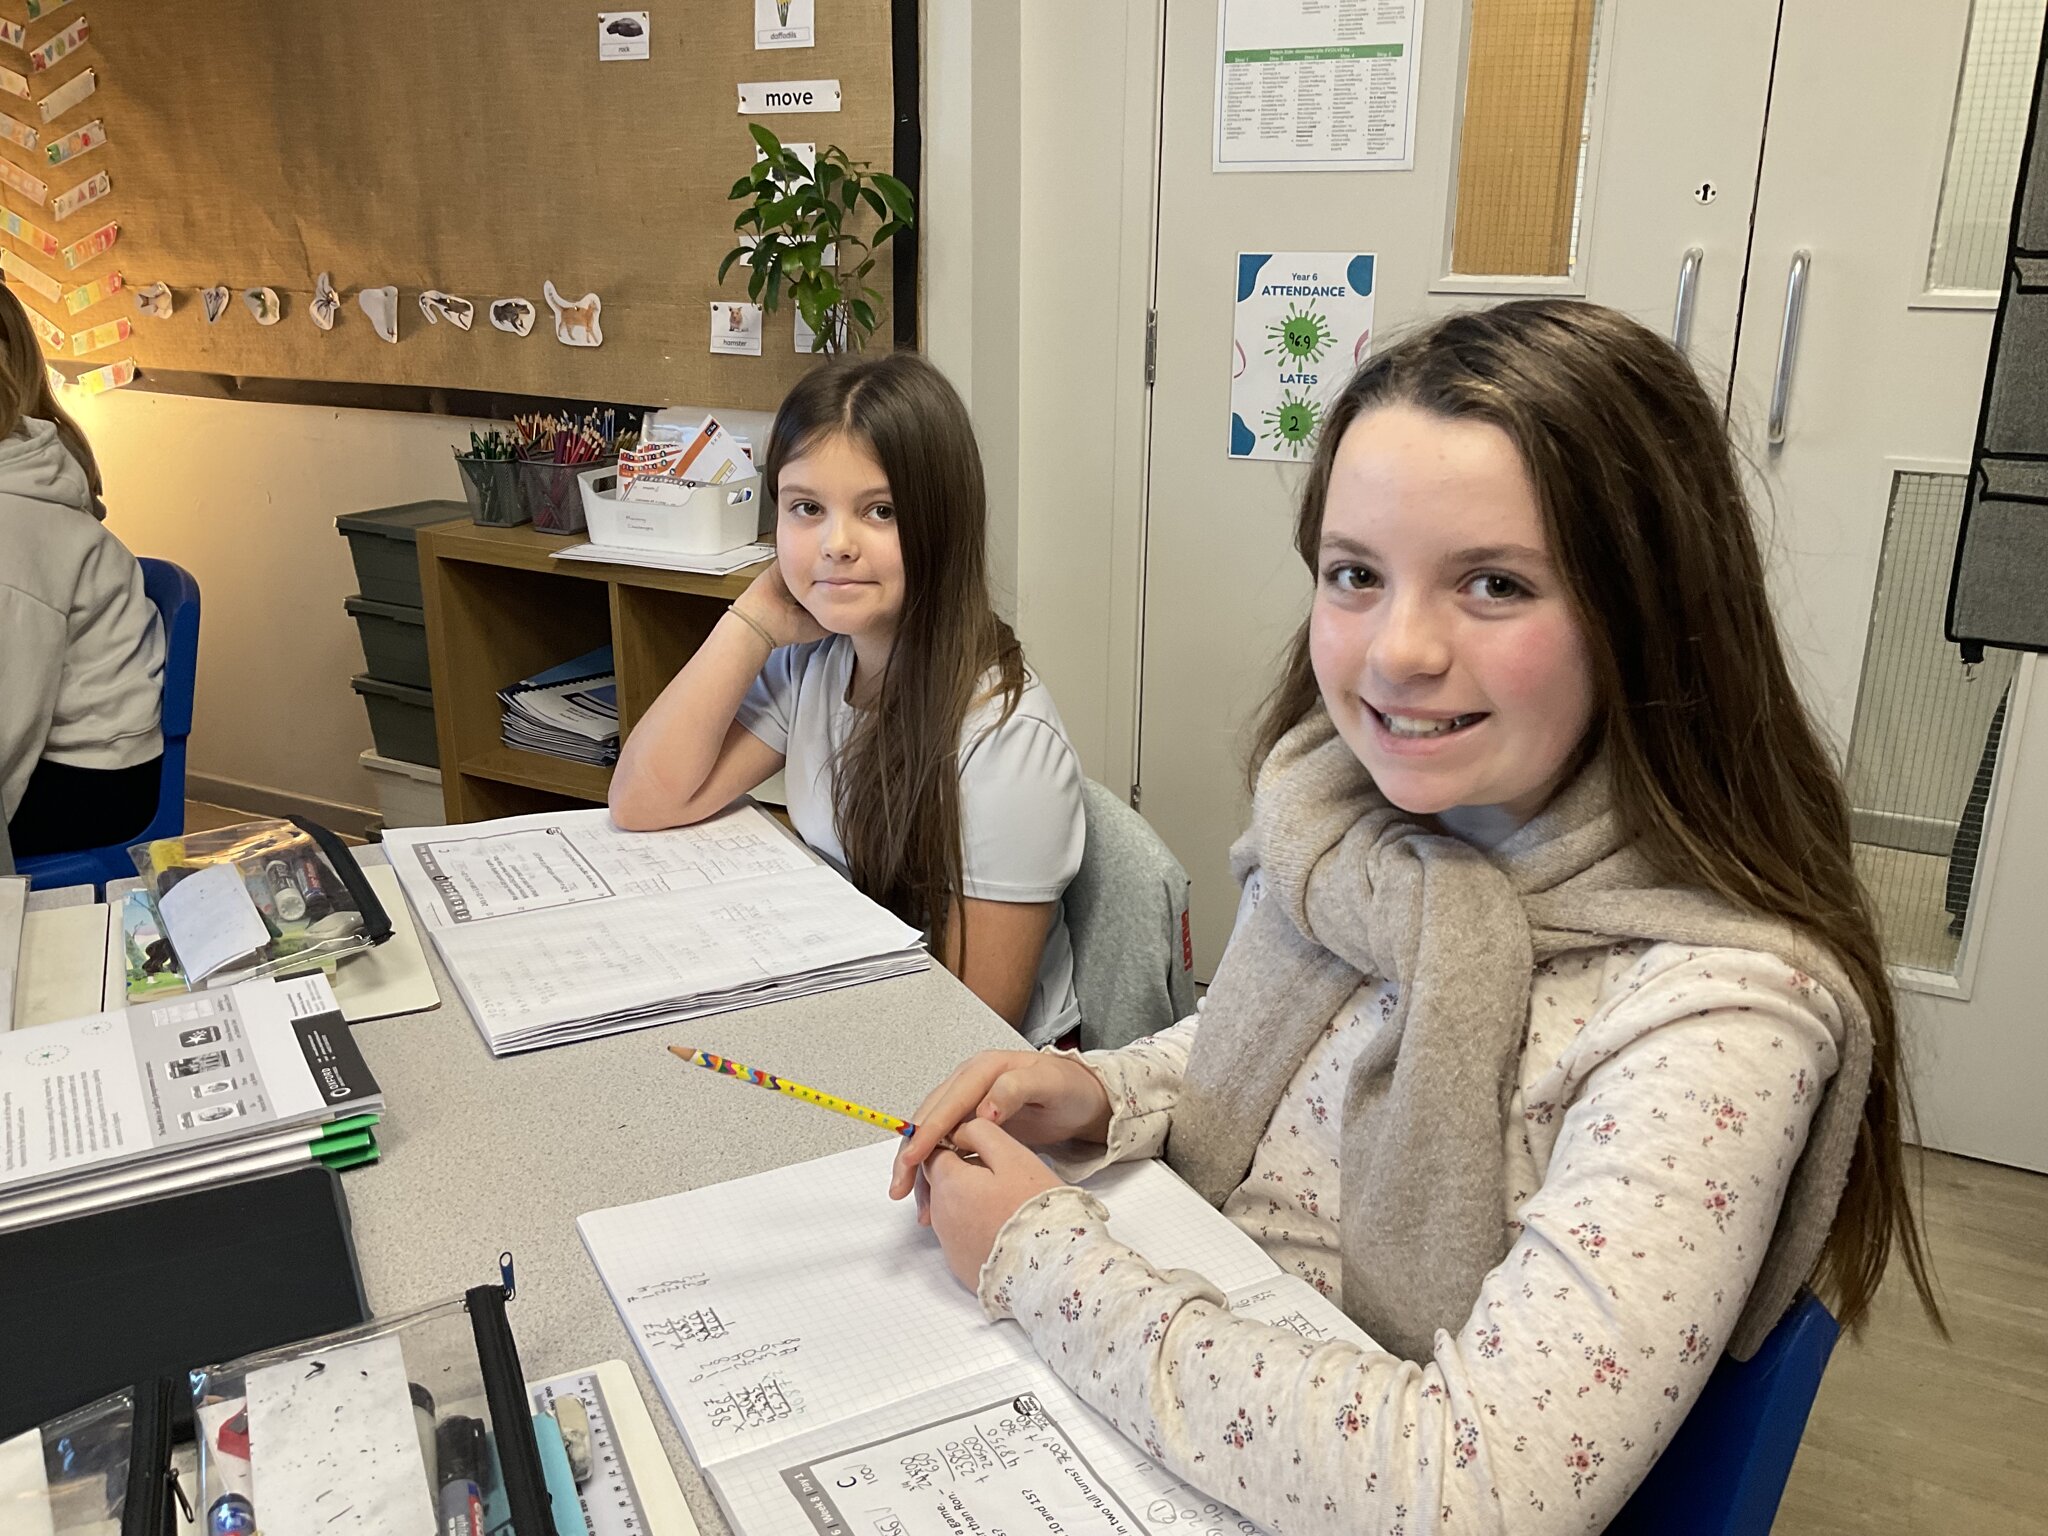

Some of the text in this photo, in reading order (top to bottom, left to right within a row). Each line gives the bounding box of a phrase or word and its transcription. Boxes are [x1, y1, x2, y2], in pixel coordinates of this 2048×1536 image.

[770, 31, 797, 40] daffodils
[765, 91, 814, 107] move
[1292, 273, 1310, 281] Year
[1262, 285, 1345, 297] ATTENDANCE
[722, 338, 747, 347] hamster
[1289, 332, 1310, 349] 96.9
[1280, 374, 1318, 384] LATES
[1289, 416, 1299, 431] 2
[321, 1067, 339, 1090] OXFORD
[799, 1478, 813, 1492] Day
[837, 1476, 857, 1488] C
[1067, 1467, 1092, 1494] turns?
[1022, 1489, 1041, 1508] 15?
[1085, 1488, 1103, 1509] full
[814, 1501, 834, 1524] Week
[937, 1502, 960, 1531] game.
[945, 1490, 980, 1532] than Ron.
[1034, 1502, 1055, 1525] and
[1099, 1505, 1120, 1528] two
